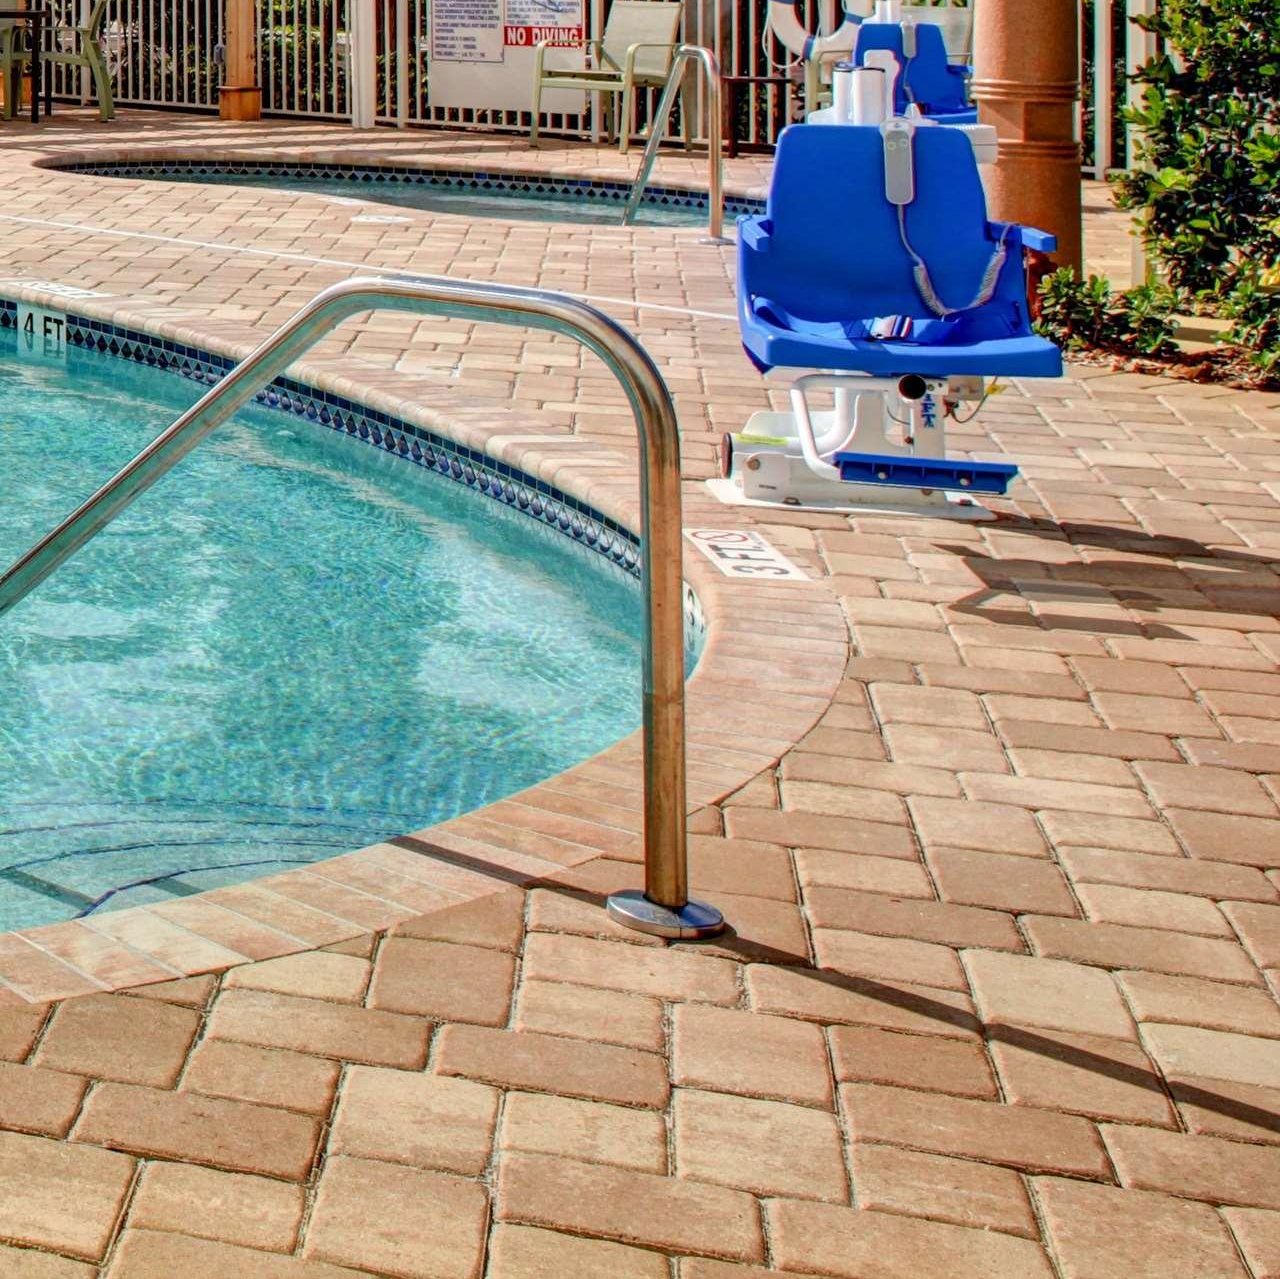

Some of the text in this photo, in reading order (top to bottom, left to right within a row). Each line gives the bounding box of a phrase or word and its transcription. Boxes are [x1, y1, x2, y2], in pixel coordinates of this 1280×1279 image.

[507, 27, 579, 46] NO DIVING
[23, 312, 64, 340] 4 FT
[731, 565, 790, 575] 3
